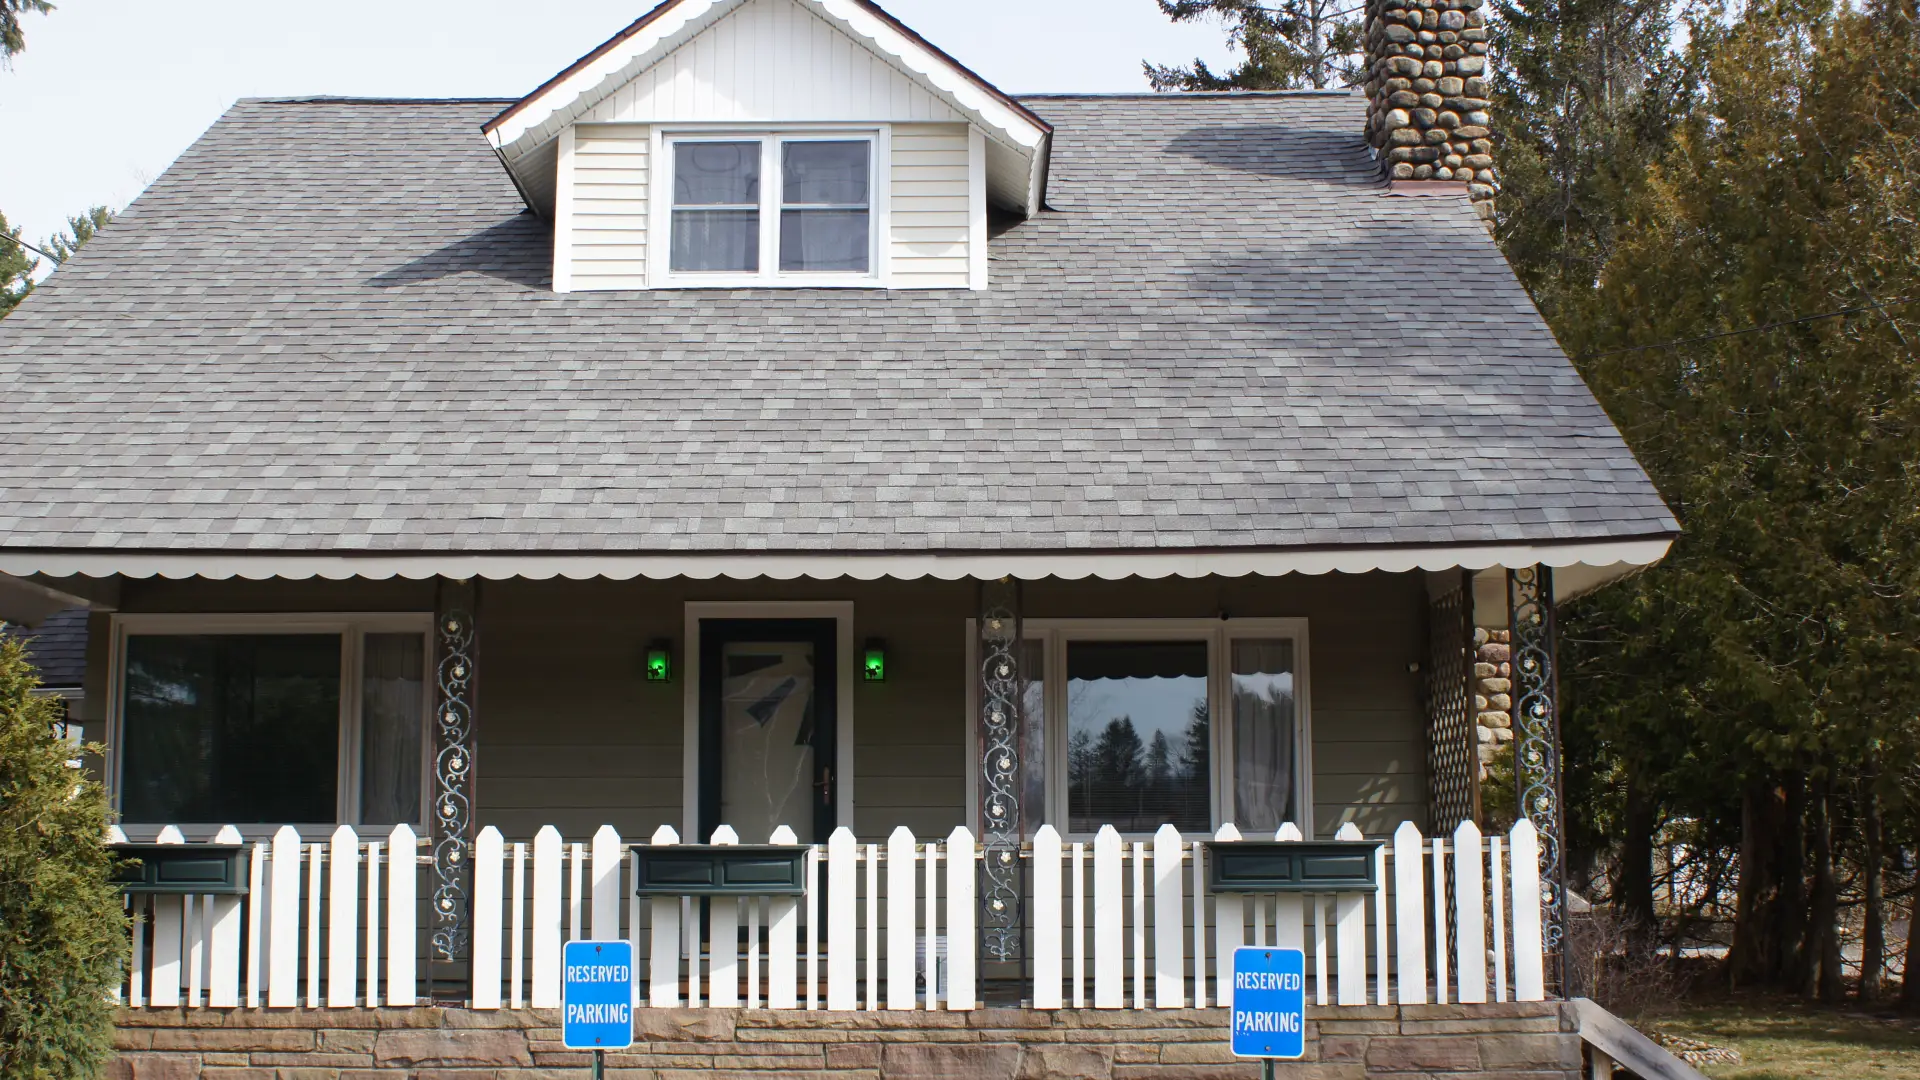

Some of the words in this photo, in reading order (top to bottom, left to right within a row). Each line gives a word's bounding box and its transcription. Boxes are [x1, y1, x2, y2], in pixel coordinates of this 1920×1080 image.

[567, 965, 629, 983] RESERVED
[1236, 972, 1300, 991] RESERVED
[567, 1003, 629, 1024] PARKING
[1236, 1011, 1300, 1033] PARKING
